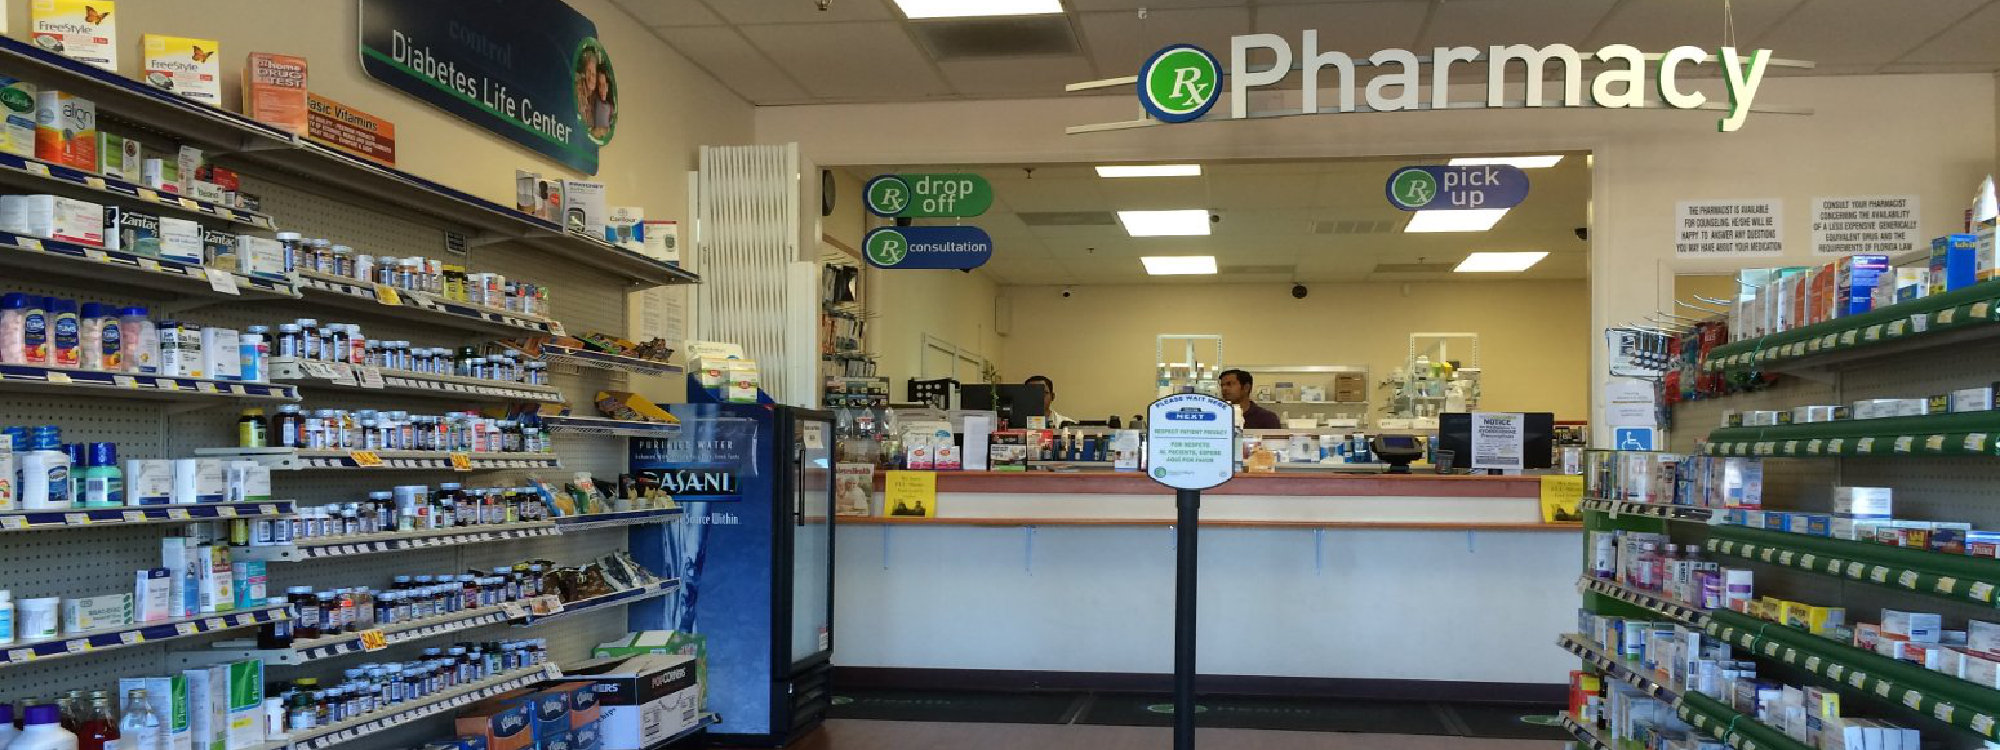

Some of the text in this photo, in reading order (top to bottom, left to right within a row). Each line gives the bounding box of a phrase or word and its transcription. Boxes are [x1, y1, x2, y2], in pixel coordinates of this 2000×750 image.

[1230, 28, 1773, 133] Pharmacy
[392, 29, 573, 146] Diabetes Life Center
[62, 101, 93, 130] align
[334, 104, 378, 132] Vitamins
[1443, 165, 1500, 193] pick
[915, 175, 974, 200] drop
[922, 193, 957, 213] off
[1451, 189, 1485, 208] up
[1823, 198, 1907, 210] CONSULT YOUR PHARMACIST
[1688, 204, 1769, 216] THE PHARMACIST IS AVAILABLE
[1820, 209, 1910, 220] CONCERNING THE AVAILABILITY
[120, 210, 159, 231] Zantac
[1684, 218, 1695, 228] FOR
[1751, 217, 1765, 226] WILL
[1765, 217, 1773, 226] BE
[1813, 223, 1822, 231] OF
[1822, 222, 1828, 231] A
[1844, 221, 1876, 231] EXPENSIVE
[1879, 220, 1917, 230] GENERICALLY
[1681, 229, 1776, 240] HAPPY TO ANSWER ANY QUESTIONS
[1825, 232, 1860, 242] EQUIVALENT
[1880, 232, 1893, 240] AND
[1894, 231, 1906, 240] THE
[909, 241, 988, 253] consultation
[1676, 241, 1782, 252] YOU MAY HAVE ABOUT YOUR MEDICATION
[1818, 242, 1913, 253] REQUIREMENTS OF FLORIDA LAW
[1185, 395, 1206, 403] WAIT
[697, 439, 734, 450] WATER
[685, 513, 711, 525] Source
